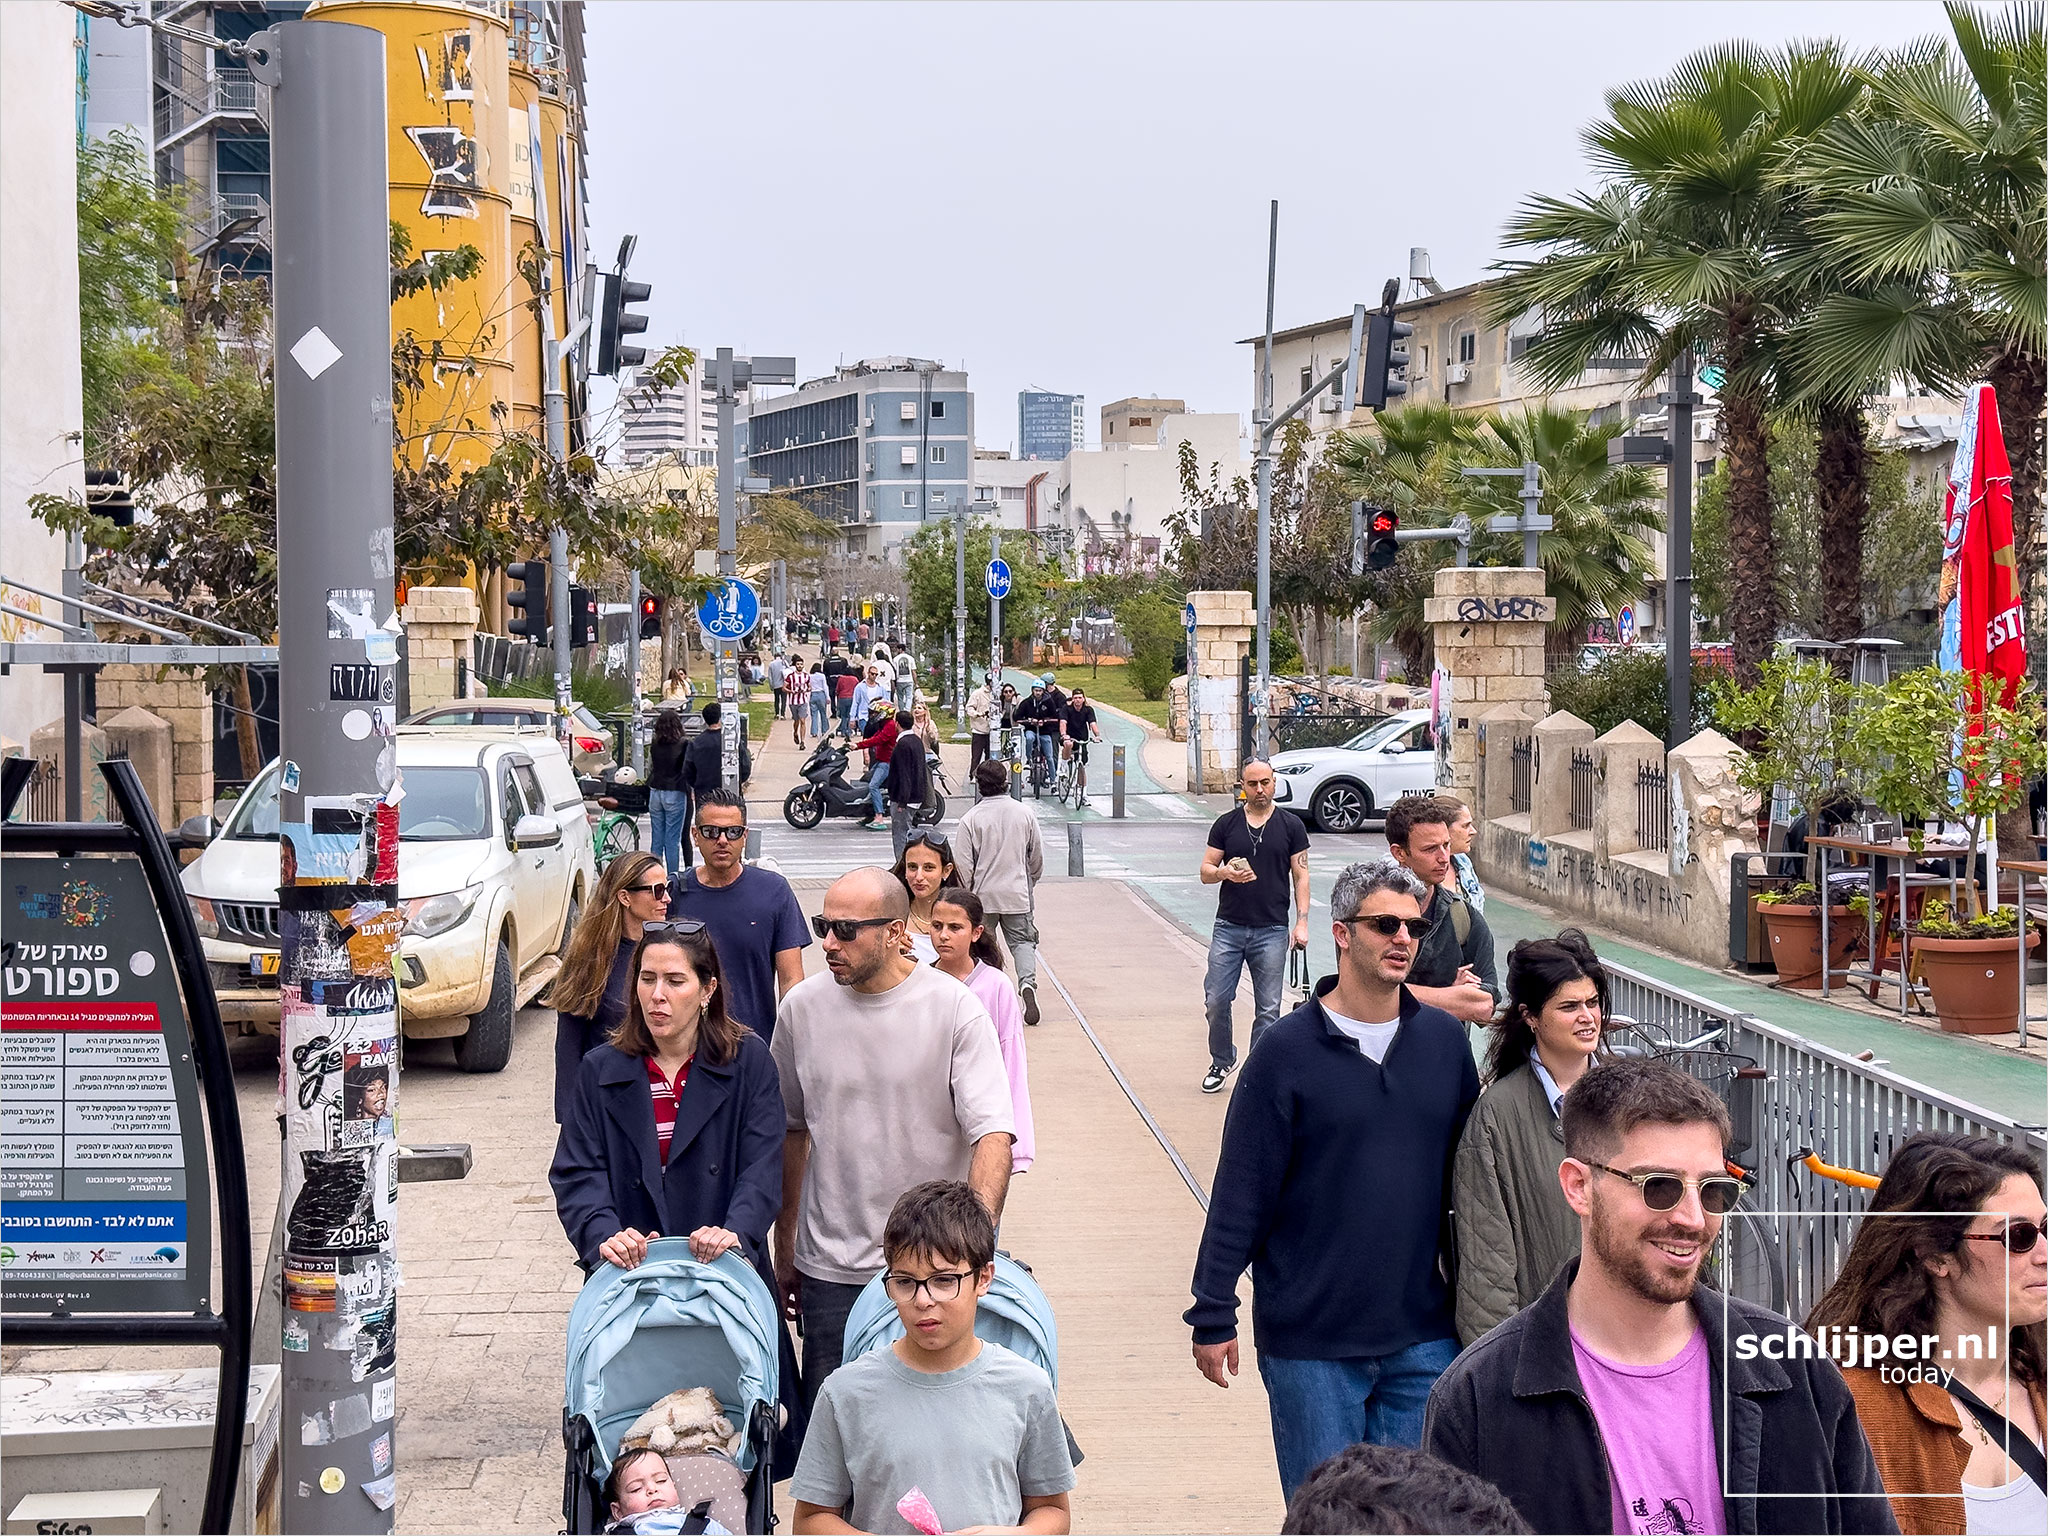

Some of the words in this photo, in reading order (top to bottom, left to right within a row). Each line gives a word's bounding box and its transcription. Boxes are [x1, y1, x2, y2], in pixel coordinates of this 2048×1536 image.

[33, 893, 47, 902] TEL
[19, 901, 39, 911] AVIV
[26, 910, 48, 919] YAFO
[17, 941, 47, 961] של
[52, 944, 108, 966] פארק
[5, 966, 120, 996] ספורט
[36, 1013, 70, 1021] ובאחריות
[70, 1013, 80, 1021] 14
[80, 1012, 98, 1021] מגיל
[98, 1012, 131, 1023] למתקנים
[131, 1013, 155, 1022] העליה
[3, 1036, 29, 1044] מבעיות
[28, 1036, 56, 1044] לסובלים
[107, 1037, 132, 1046] בפארק
[132, 1036, 161, 1045] הפעילות
[19, 1045, 41, 1054] משקל
[68, 1046, 95, 1054] לאנשים
[94, 1046, 121, 1054] ומיועדת
[145, 1046, 160, 1054] ללא
[5, 1055, 27, 1063] אסורה
[27, 1054, 56, 1063] הפעילות
[24, 1073, 45, 1081] לעבוד
[45, 1074, 56, 1083] אין
[79, 1074, 103, 1083] המתקן
[102, 1074, 126, 1083] תקינות
[137, 1073, 159, 1083] לבדוק
[159, 1074, 168, 1082] יש
[8, 1083, 30, 1091] הכתוב
[30, 1083, 39, 1091] מן
[39, 1083, 56, 1091] שונה
[102, 1083, 125, 1091] תחילת
[125, 1082, 140, 1091] לפני
[140, 1083, 168, 1091] ושלמותו
[24, 1107, 45, 1116] לעבוד
[45, 1108, 55, 1117] אין
[75, 1105, 91, 1113] דקה
[91, 1104, 102, 1112] של
[101, 1105, 127, 1113] הפסקה
[126, 1104, 137, 1112] על
[137, 1104, 163, 1113] להקפיד
[41, 1117, 55, 1125] ללא
[80, 1113, 105, 1121] לתרגיל
[104, 1113, 125, 1121] תרגיל
[124, 1114, 135, 1122] בין
[134, 1113, 157, 1121] לפחות
[129, 1122, 151, 1132] לדופק
[151, 1122, 171, 1131] (חזרה
[10, 1142, 33, 1151] לעשות
[33, 1142, 55, 1151] מומלץ
[75, 1142, 102, 1152] להפסיק
[111, 1142, 134, 1151] להנאה
[134, 1143, 147, 1151] הוא
[147, 1143, 173, 1151] השימוש
[26, 1152, 55, 1160] הפעילות
[111, 1151, 122, 1160] לא
[122, 1152, 133, 1160] אם
[133, 1151, 162, 1160] הפעילות
[161, 1152, 173, 1160] את
[7, 1172, 18, 1181] על
[18, 1172, 45, 1182] להקפיד
[44, 1173, 54, 1181] יש
[85, 1176, 104, 1184] נכונה
[104, 1176, 126, 1184] נשימה
[126, 1176, 137, 1184] על
[137, 1176, 163, 1185] להקפיד
[163, 1176, 173, 1184] יש
[16, 1180, 29, 1189] לפי
[28, 1180, 54, 1189] התרגיל
[156, 1184, 173, 1192] בעת
[43, 1215, 93, 1227] התחשבו
[101, 1214, 126, 1227] לבד
[127, 1214, 145, 1227] לא
[147, 1215, 175, 1227] אתם
